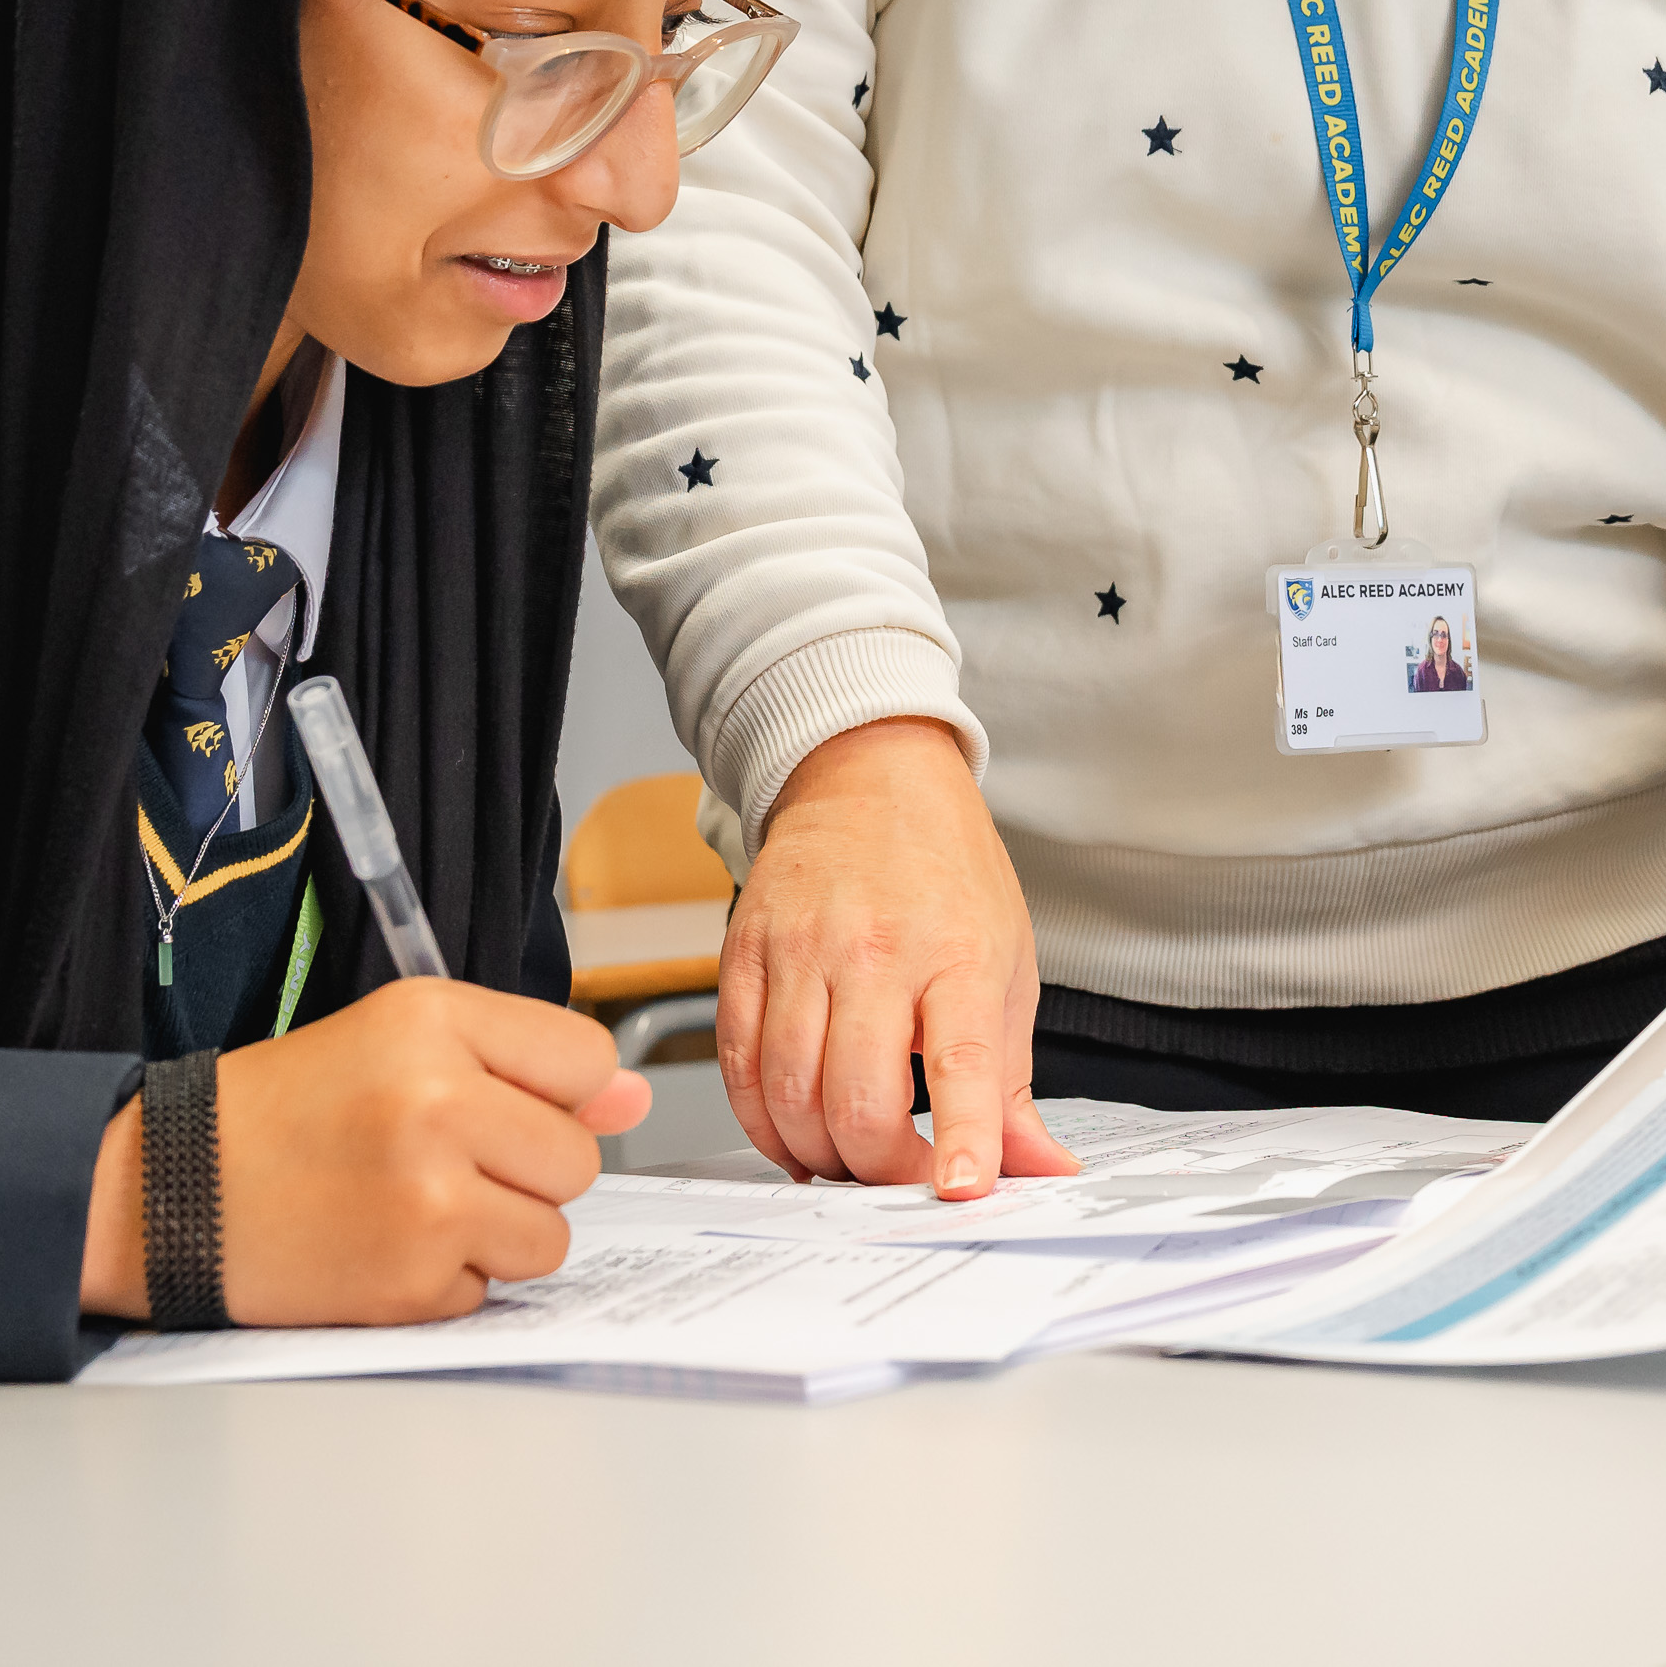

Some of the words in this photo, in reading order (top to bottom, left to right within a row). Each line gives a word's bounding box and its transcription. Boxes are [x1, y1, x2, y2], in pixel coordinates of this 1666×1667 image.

[1306, 24, 1343, 107] REED
[1323, 114, 1366, 274] ACADEMY
[1378, 204, 1427, 280] ALEC
[1422, 118, 1465, 199] REED
[1320, 584, 1355, 599] ALEC
[1359, 583, 1394, 598] REED
[1398, 582, 1465, 597] ACADEMY
[1292, 635, 1313, 648] Staff
[1315, 635, 1337, 647] Card
[1294, 708, 1308, 720] Ms
[1316, 706, 1334, 718] Dee
[1291, 724, 1308, 735] 389
